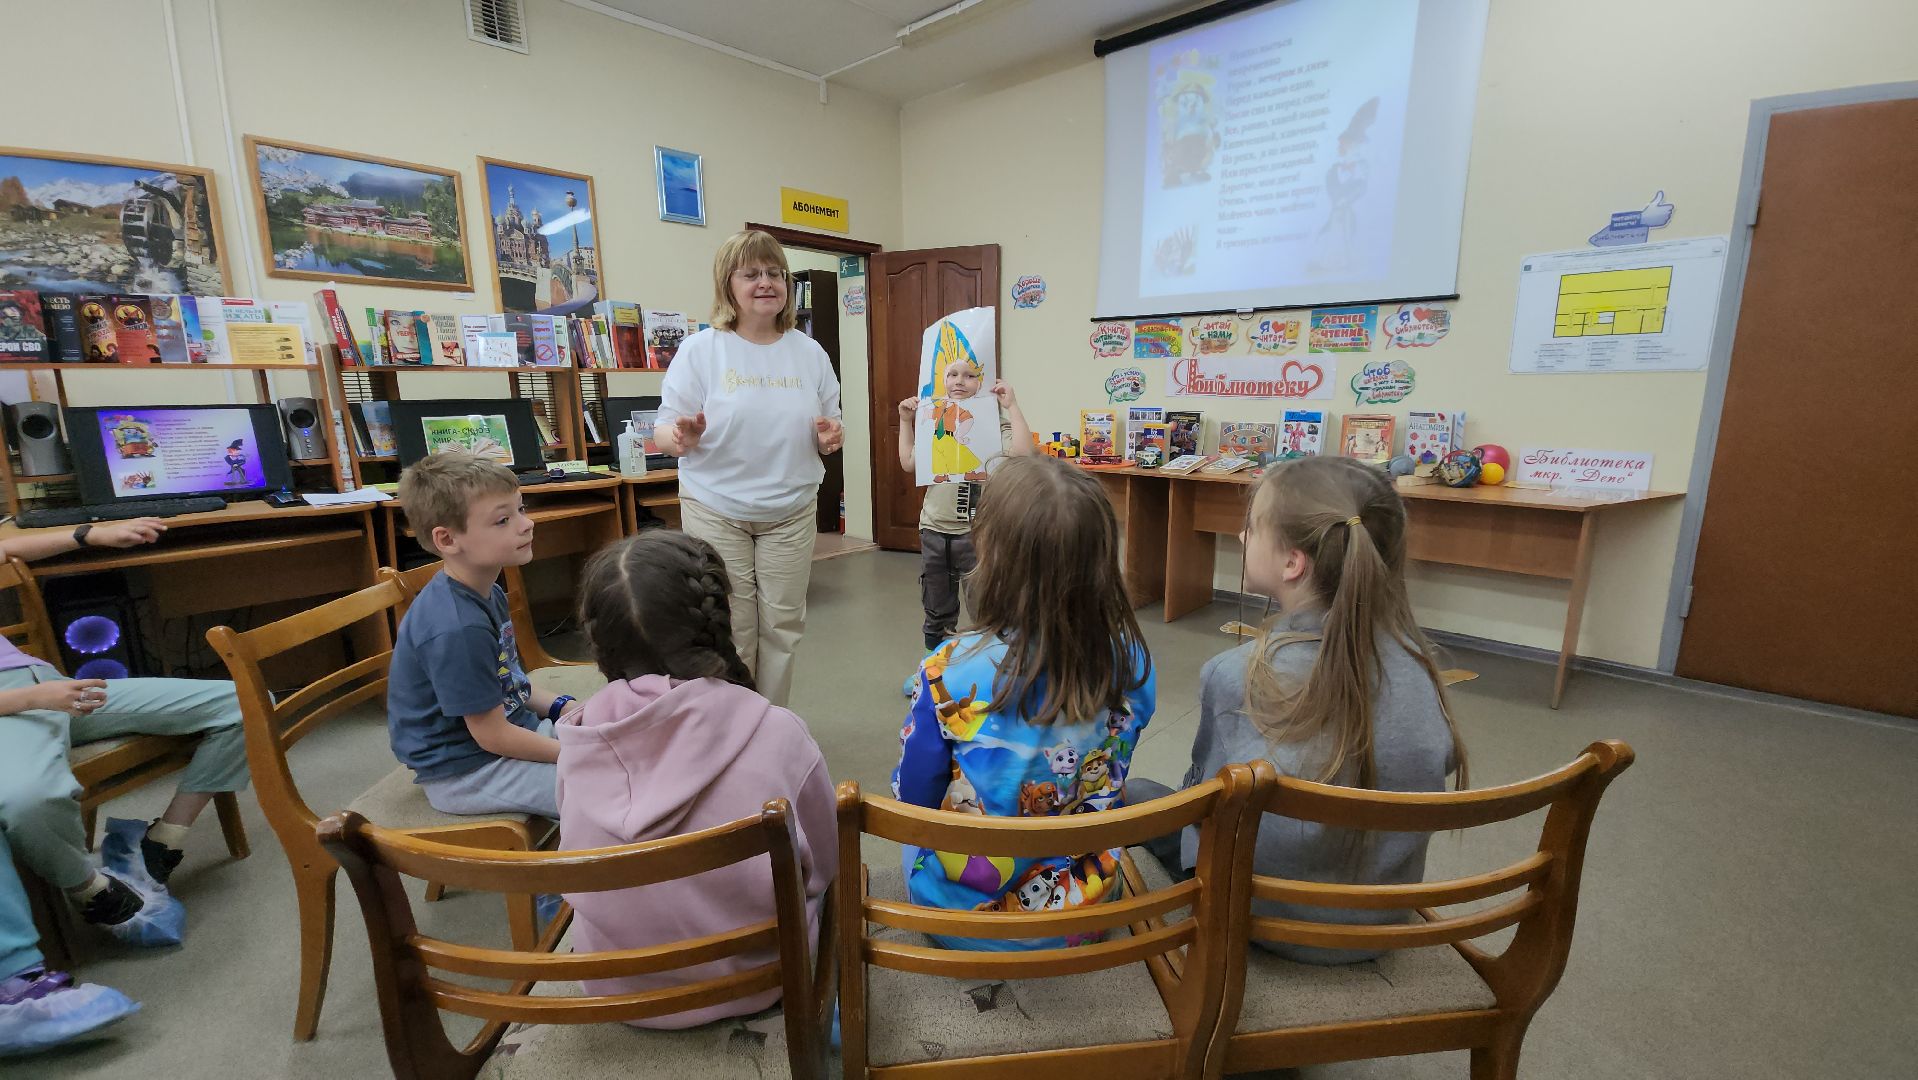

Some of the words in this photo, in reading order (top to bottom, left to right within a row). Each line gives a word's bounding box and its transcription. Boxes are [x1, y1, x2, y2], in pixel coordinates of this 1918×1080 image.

[793, 200, 840, 219] АБОНЕМЕНТ
[1321, 314, 1366, 324] ЛЕТНЕЕ
[1399, 311, 1411, 325] Я
[1260, 320, 1271, 335] Я
[0, 342, 21, 352] ЕРОИ
[1408, 422, 1445, 432] АНАТОМИЯ
[1523, 449, 1646, 470] Библиотека
[1529, 468, 1563, 483] мкр.
